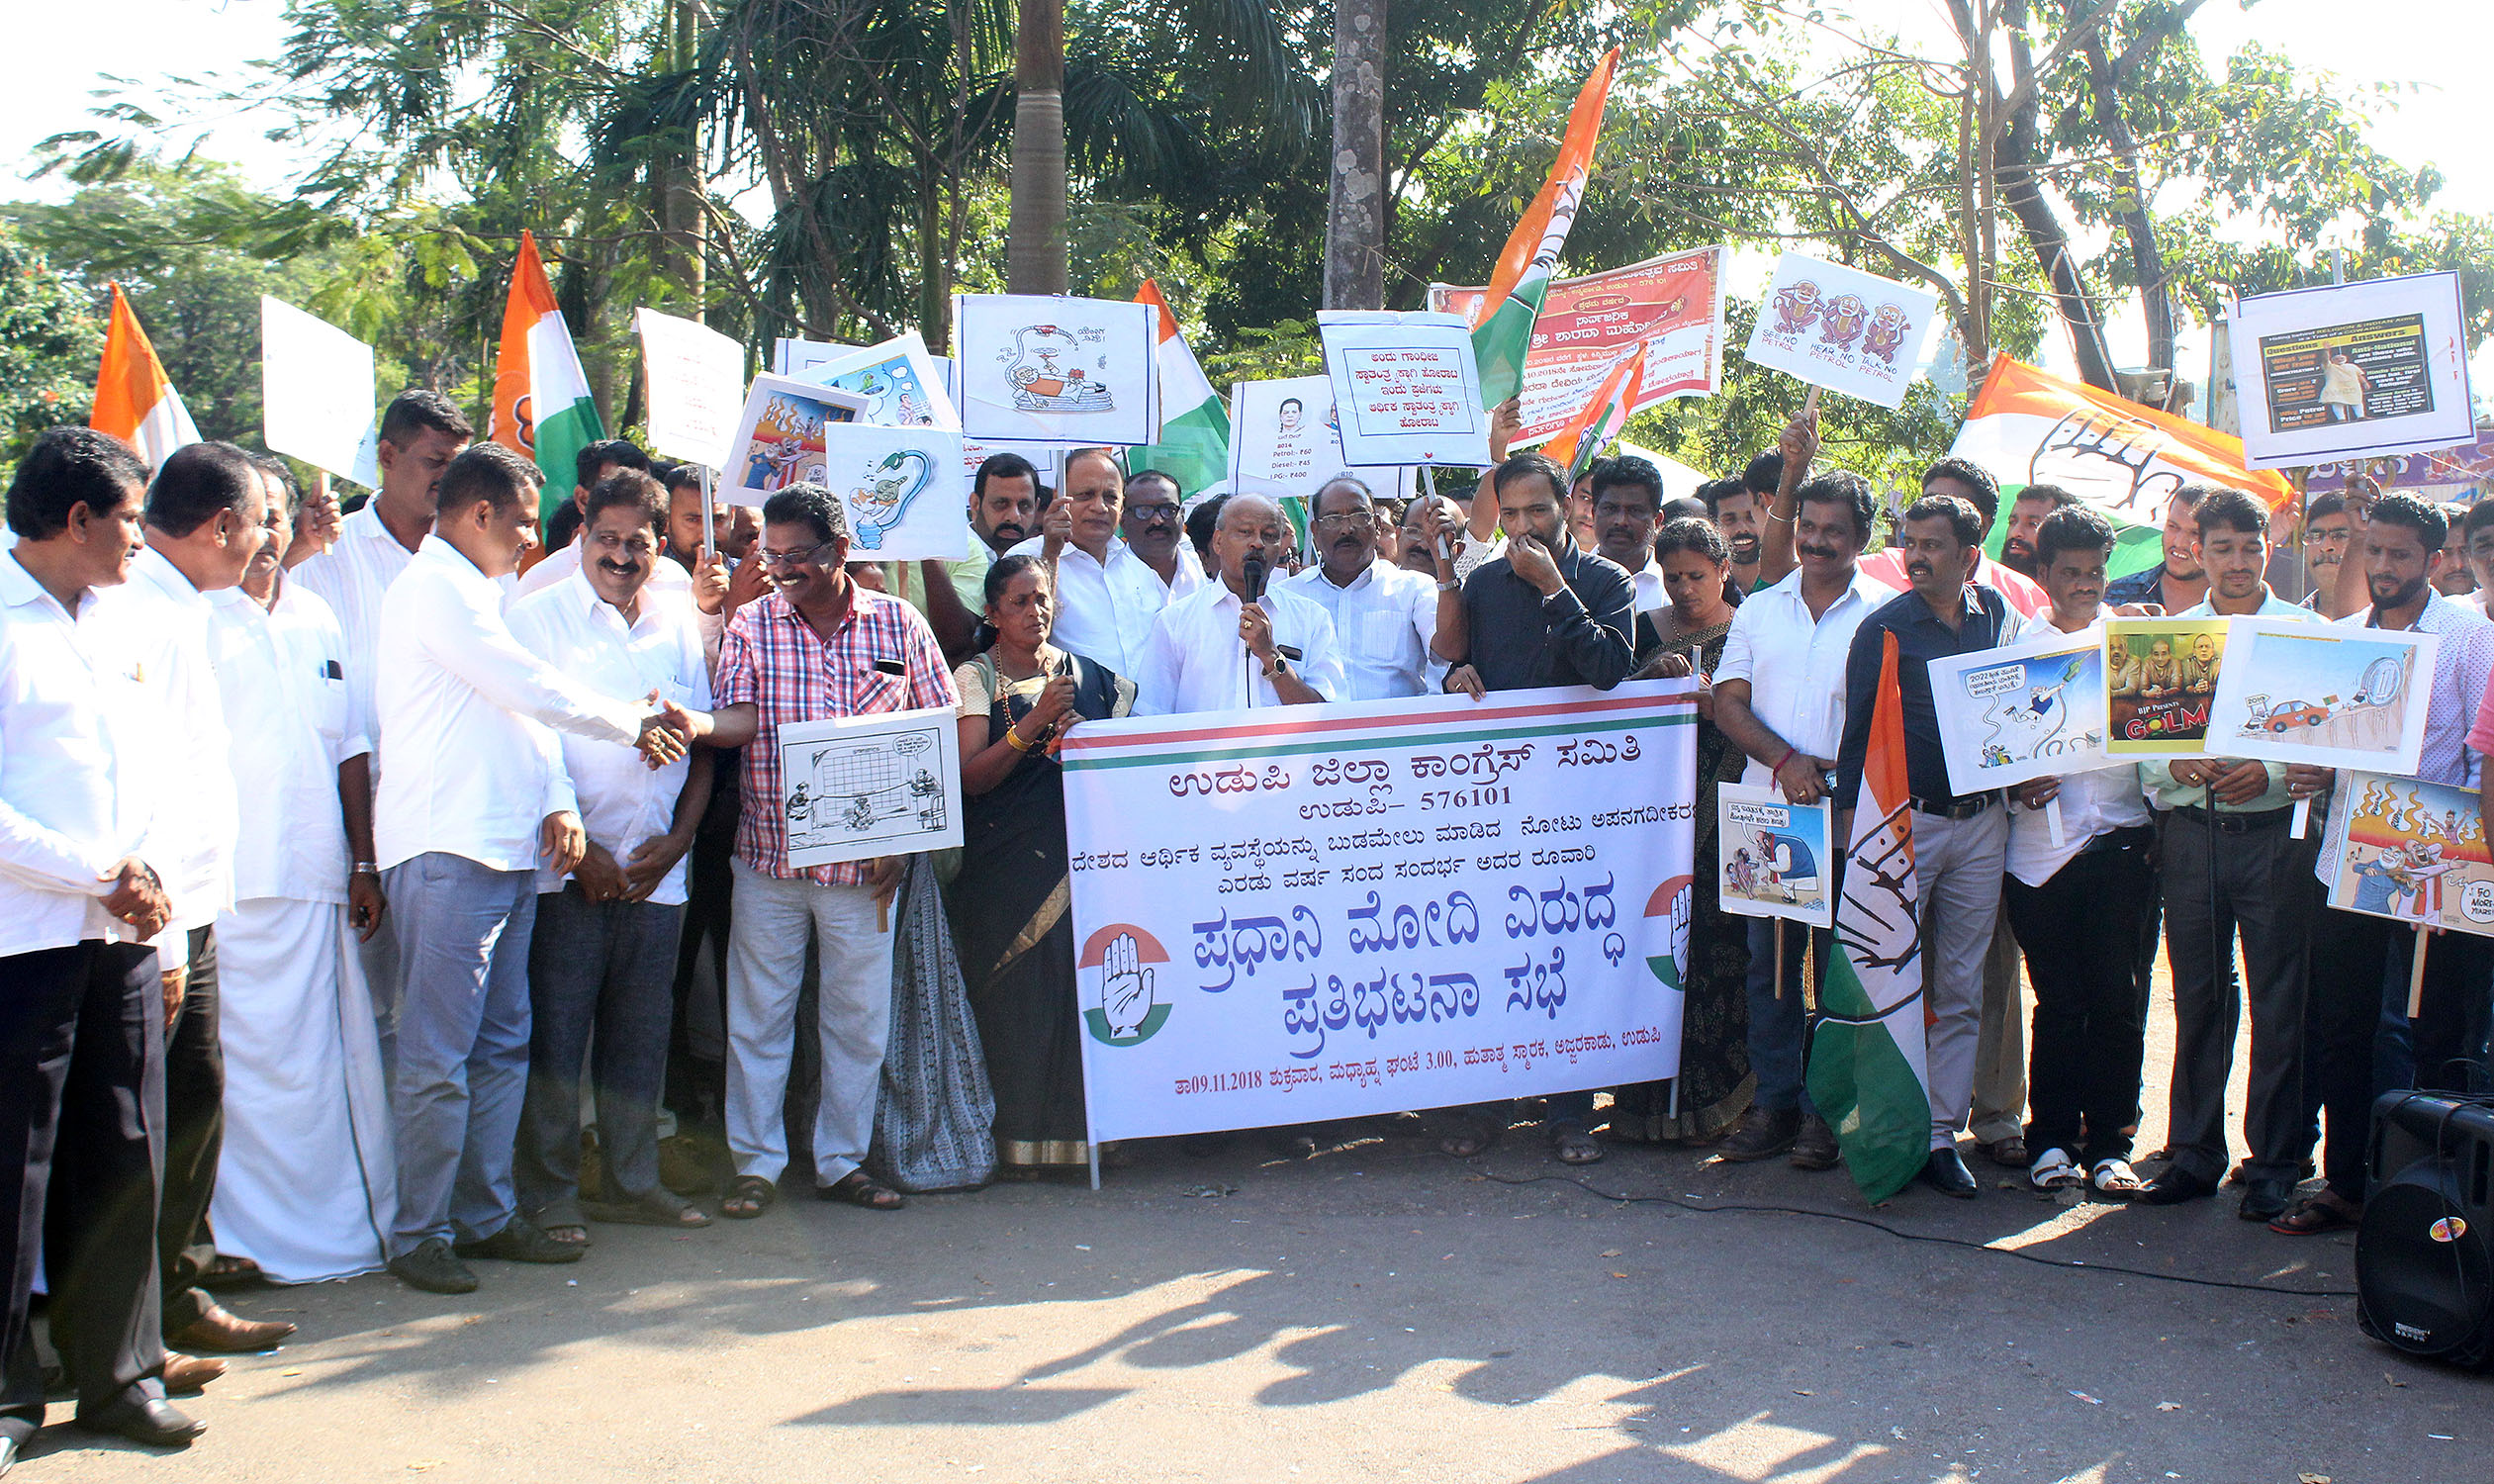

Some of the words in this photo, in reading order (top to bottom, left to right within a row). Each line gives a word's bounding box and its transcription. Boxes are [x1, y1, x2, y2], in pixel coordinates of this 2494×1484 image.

[1576, 311, 1629, 327] ಸಾರ್ವಜನಿಕ
[1532, 333, 1549, 348] ಶ್ರೀ
[1555, 327, 1600, 342] ಶಾರದಾ
[1762, 336, 1795, 352] PETROL
[1763, 329, 1780, 339] SEE
[1784, 336, 1798, 345] NO
[2351, 329, 2406, 342] Answers
[1810, 343, 1835, 356] HEAR
[1840, 352, 1855, 363] NO
[2266, 342, 2319, 355] Questions
[2352, 339, 2416, 354] Anti-National
[1809, 351, 1848, 369] PETROL
[1861, 356, 1882, 370] TALK
[1885, 366, 1897, 375] NO
[1859, 366, 1894, 383] PETROL
[2298, 406, 2325, 415] Petrol
[2137, 705, 2151, 715] BJP
[2125, 703, 2209, 741] GOLM
[1169, 763, 1291, 797] ಉಡುಪಿ
[1312, 757, 1393, 796] ಜಿಲ್ಲಾ
[1411, 743, 1535, 786] ಕಾಂಗ್ರೆಸ್
[1556, 735, 1641, 769] ಸಮಿತಿ
[1421, 786, 1513, 811] 576101
[1071, 850, 1129, 872] ದೇಶದ
[1140, 843, 1200, 870] ಆರ್ಥಿಕ
[1210, 835, 1320, 871] ವ್ಯವಸ್ಥೆಯನ್ನು
[1328, 827, 1425, 851] ಬುಡಮೇಲು
[1435, 818, 1502, 843] ಮಾಡಿದ
[1521, 813, 1582, 837] ನೋಟು
[1218, 871, 1272, 894] ಎರಡು
[1283, 867, 1331, 888] ವರ್ಷ
[1340, 862, 1384, 883] ಸಂದ
[1394, 857, 1465, 880] ಸಂದರ್ಭ
[1476, 850, 1522, 871] ಅದರ
[1531, 845, 1597, 866] ರೂವಾರಿ
[2477, 887, 2490, 897] 50
[1192, 904, 1323, 993] ಪ್ರಧಾನಿ
[1347, 889, 1480, 955] ಮೋದಿ
[1505, 871, 1625, 968] ವಿರುದ್ಧ
[1282, 966, 1480, 1060] ಪ್ರತಿಭಟನಾ
[1504, 946, 1567, 1020] ಸಭೆ
[1269, 1063, 1323, 1093] ಶುಕ್ರವಾರ,
[1330, 1057, 1382, 1088] ಮಧ್ಯಾಹ್ನ
[1387, 1051, 1419, 1077] ಘಂಟೆ
[1426, 1050, 1457, 1070] 3.00,
[1463, 1042, 1509, 1073] ಹುತಾತ್ಮ
[1513, 1038, 1549, 1070] ಸ್ಮಾರಕ,
[1621, 1025, 1661, 1047] ಉಡುಪಿ
